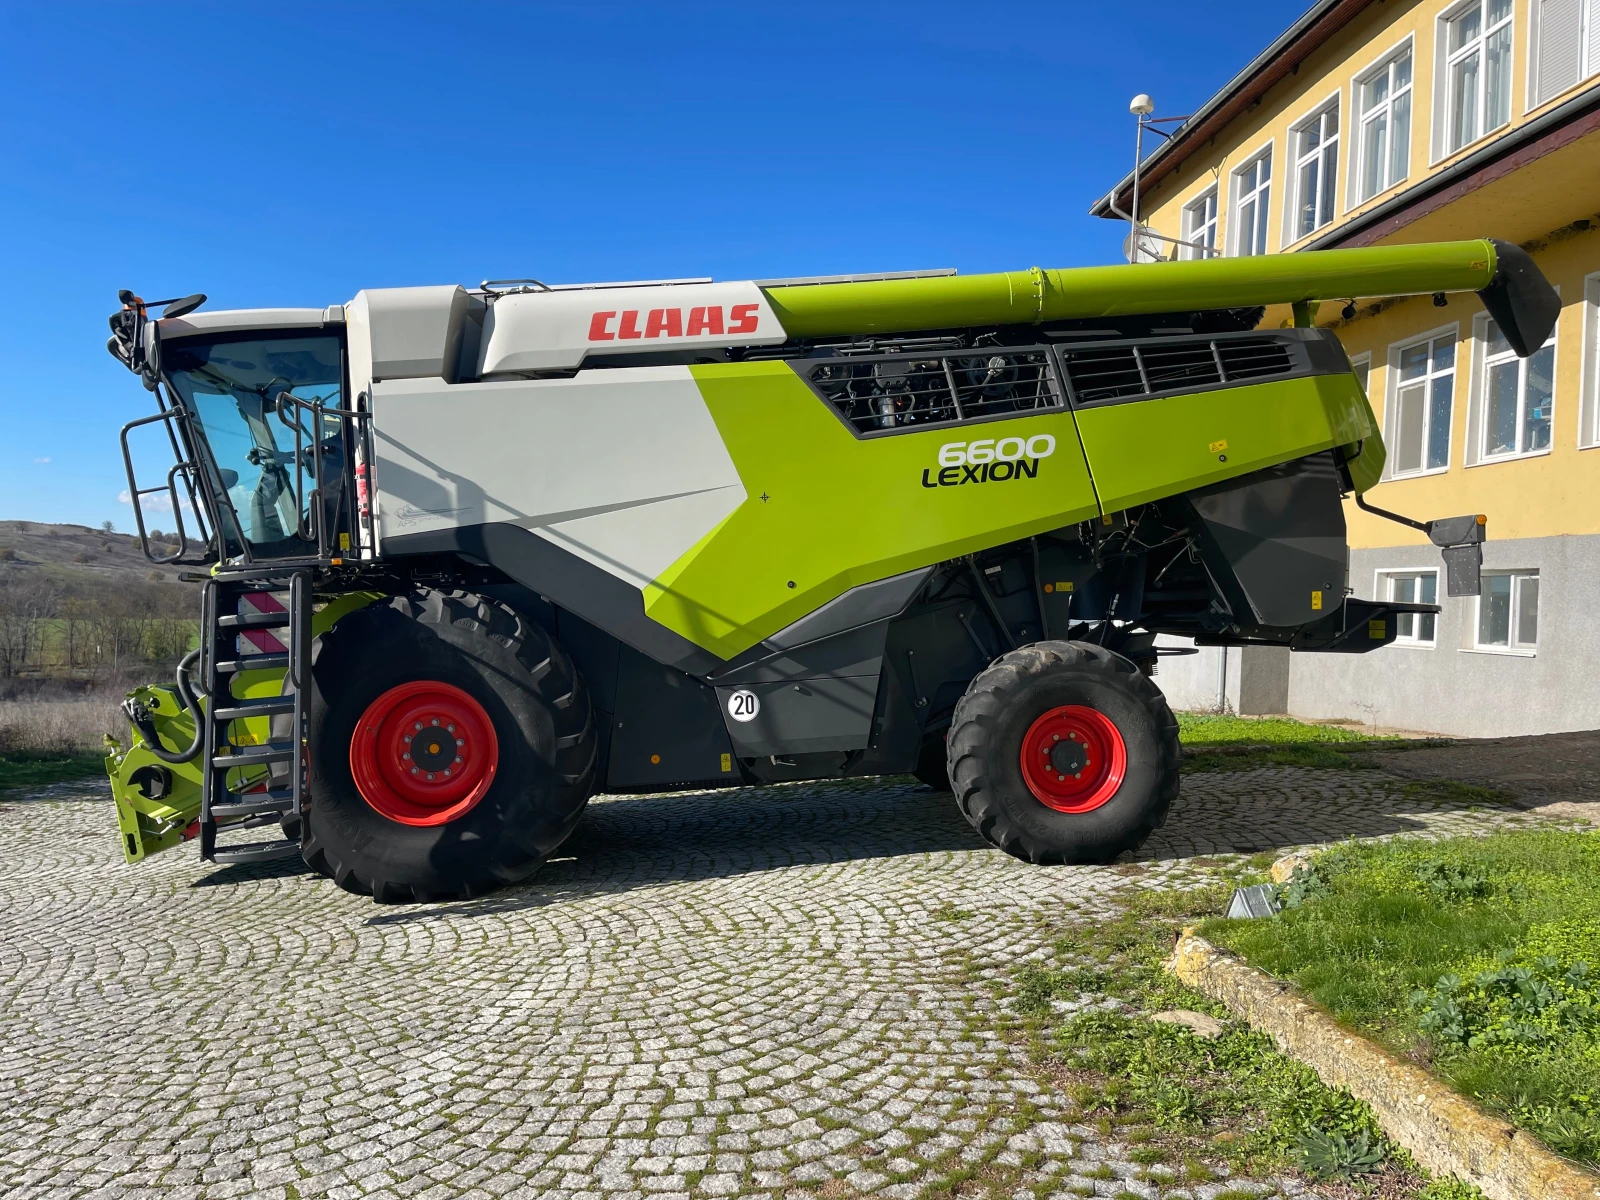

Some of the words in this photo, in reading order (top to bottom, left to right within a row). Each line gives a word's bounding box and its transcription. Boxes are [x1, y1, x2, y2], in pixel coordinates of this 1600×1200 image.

[588, 304, 760, 341] CLAAS
[938, 434, 1056, 467] 6600
[922, 458, 1039, 488] LEXION
[397, 519, 417, 528] APS
[734, 694, 755, 715] 20
